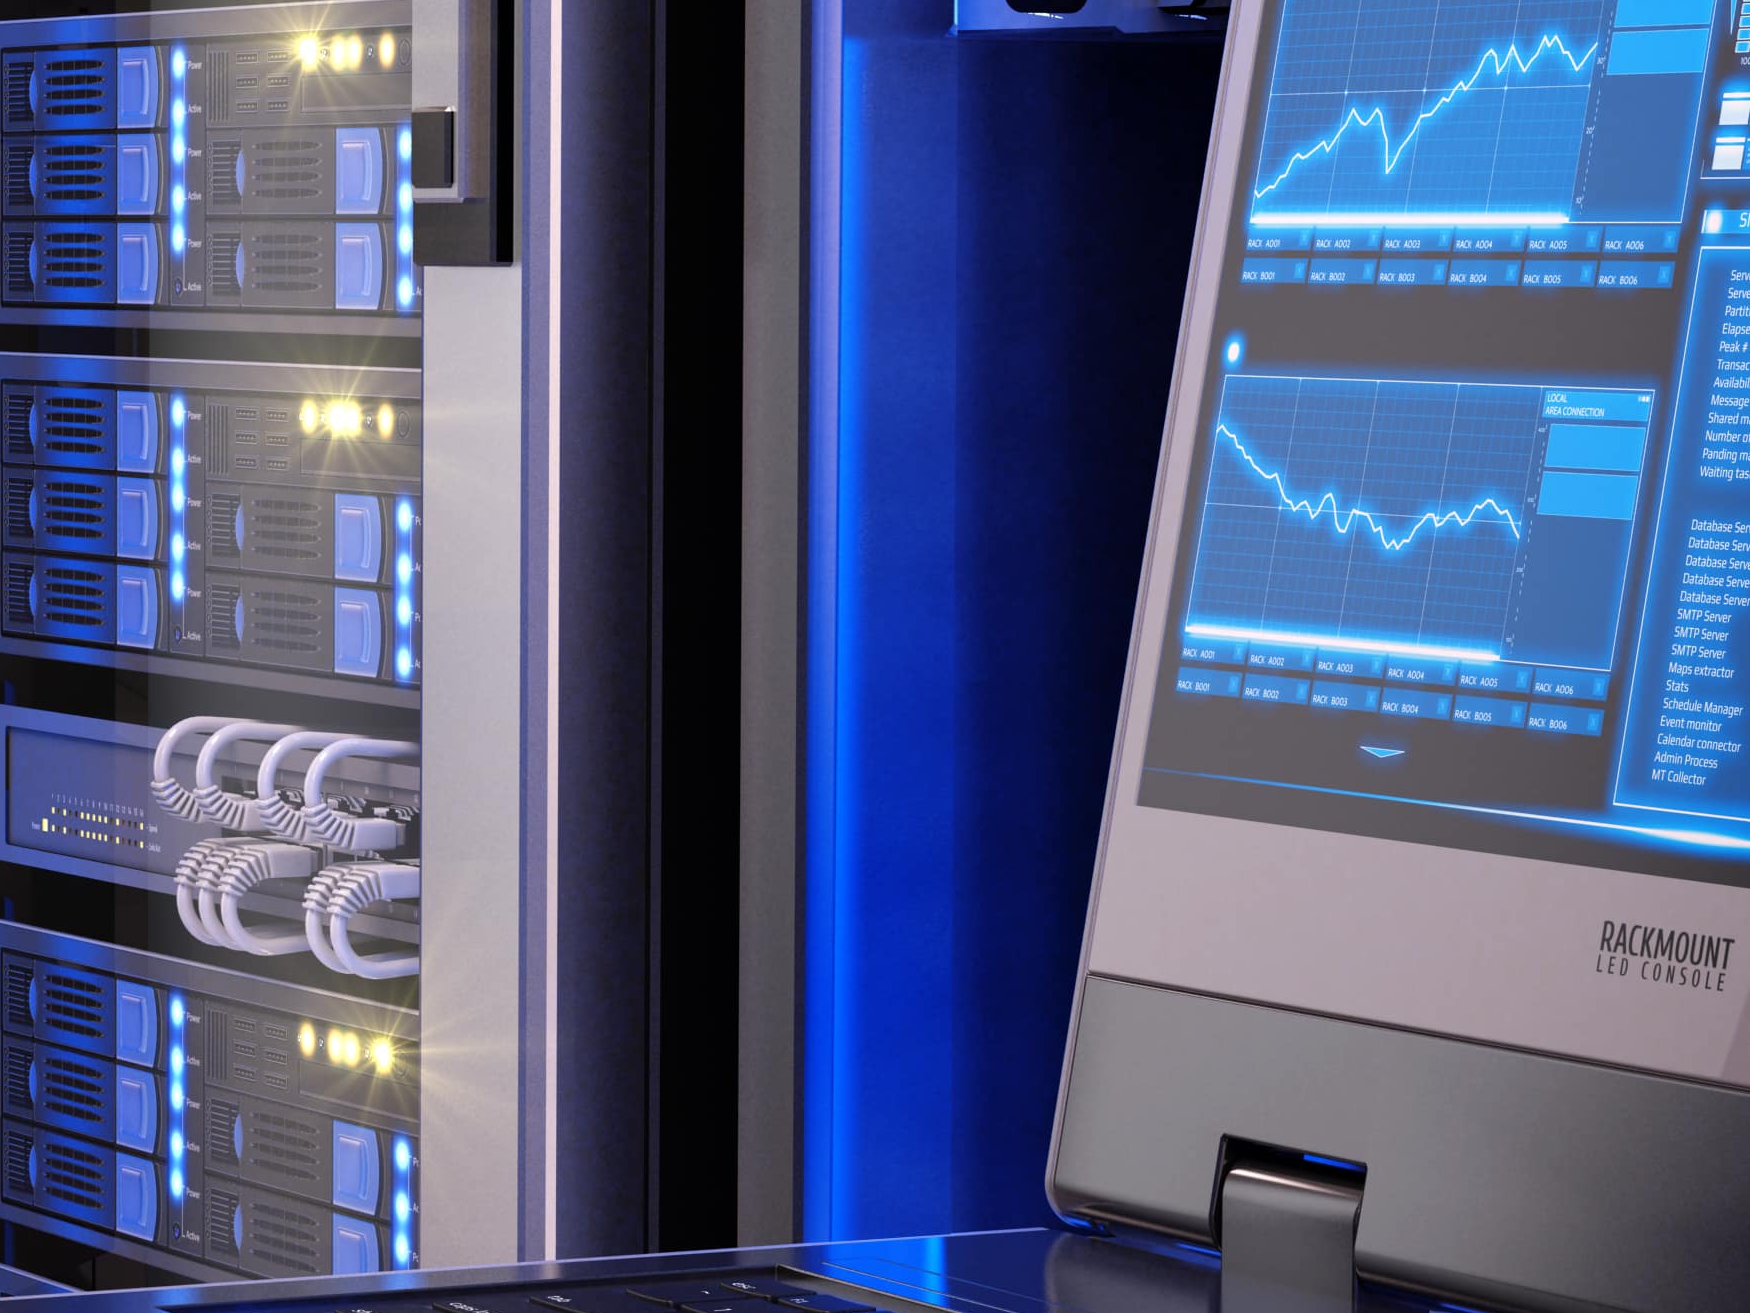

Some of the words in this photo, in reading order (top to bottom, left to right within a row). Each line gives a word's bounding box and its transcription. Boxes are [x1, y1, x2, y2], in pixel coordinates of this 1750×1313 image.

[1719, 340, 1741, 353] Peak
[1742, 341, 1749, 353] #
[1547, 393, 1568, 403] LOCAL
[1545, 405, 1562, 415] AREA
[1562, 406, 1605, 417] CONNECTION
[1690, 518, 1733, 533] Database
[1599, 920, 1735, 970] RACKMOUNT
[1596, 954, 1629, 977] LED
[1641, 960, 1726, 992] CONSOLE
